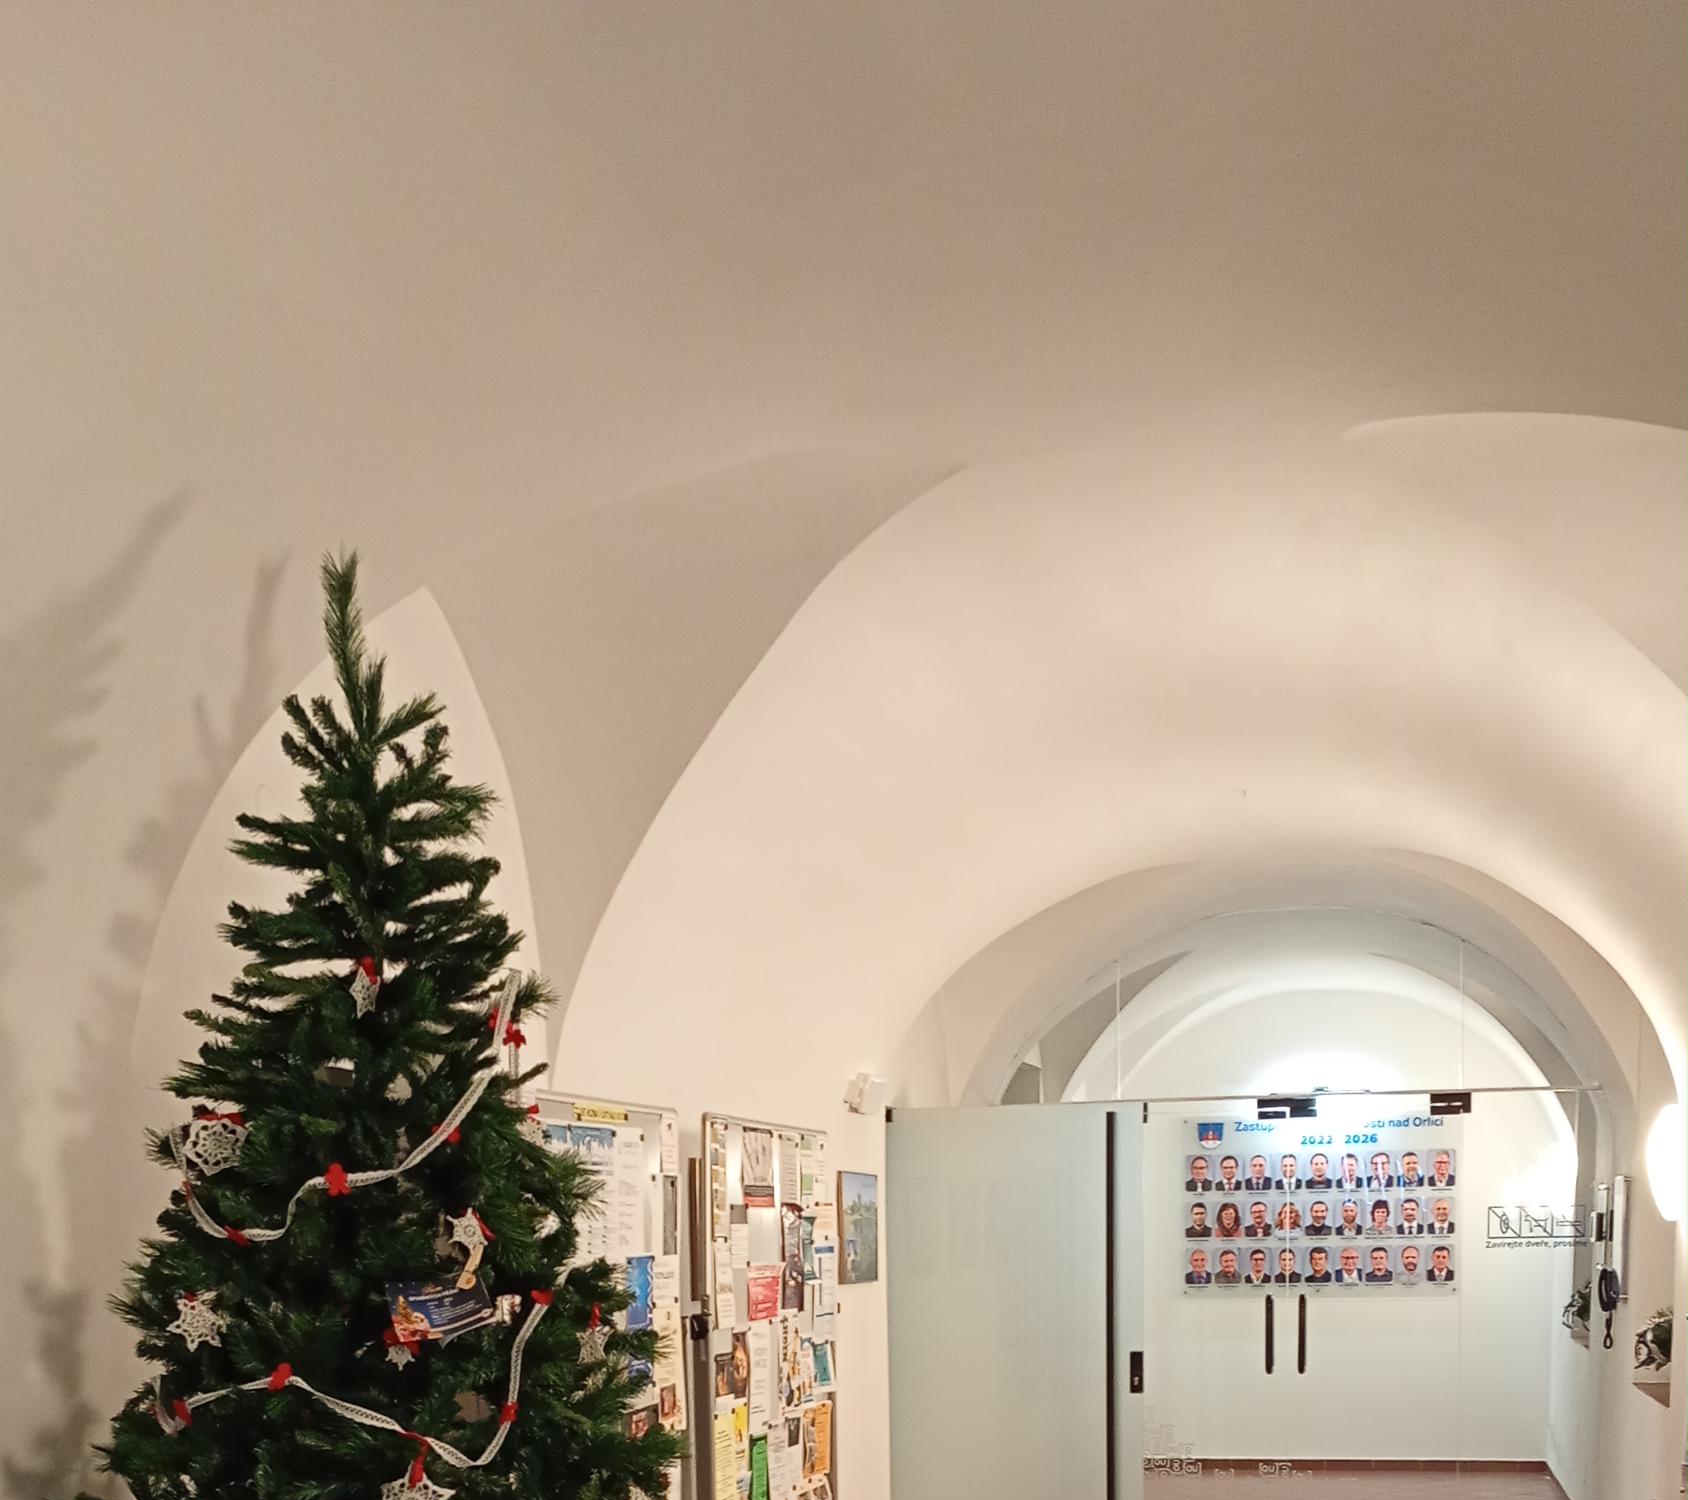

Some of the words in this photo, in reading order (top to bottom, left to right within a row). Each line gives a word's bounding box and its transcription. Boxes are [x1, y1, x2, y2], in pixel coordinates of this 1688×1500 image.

[1388, 1117, 1410, 1128] nad
[1412, 1116, 1444, 1127] Orlicí
[1300, 1135, 1334, 1145] 2022
[1344, 1133, 1378, 1144] 2026
